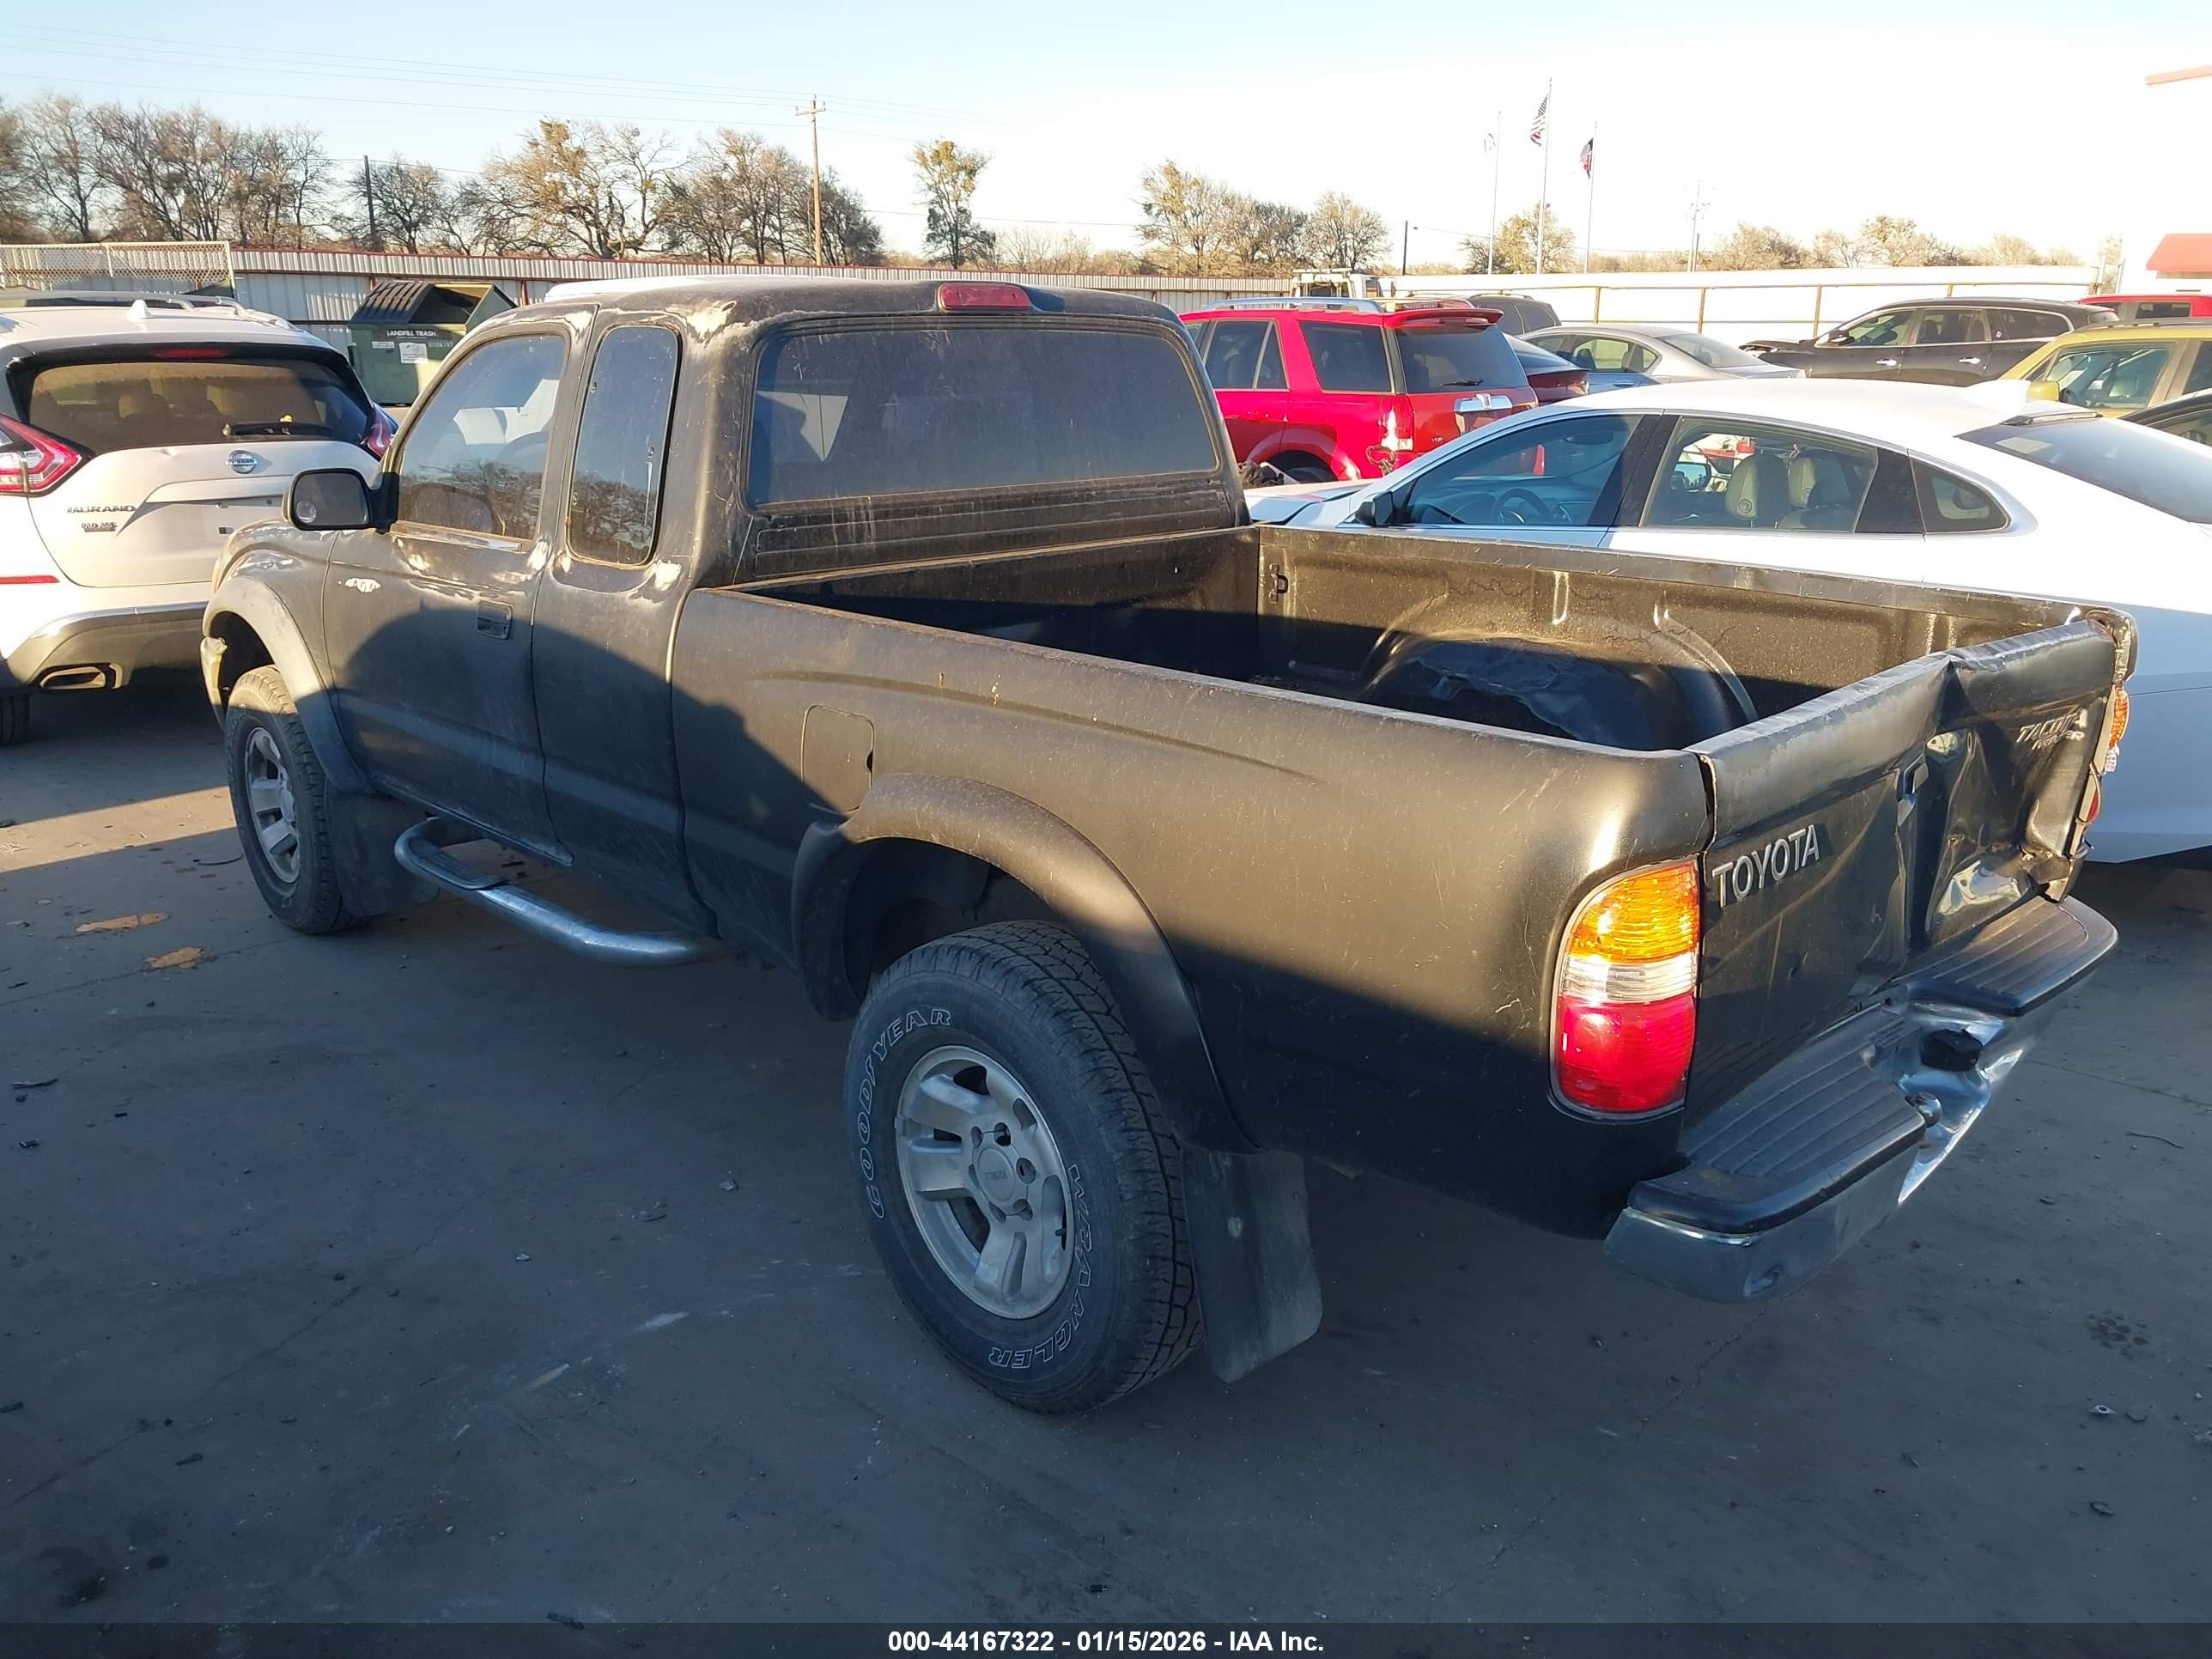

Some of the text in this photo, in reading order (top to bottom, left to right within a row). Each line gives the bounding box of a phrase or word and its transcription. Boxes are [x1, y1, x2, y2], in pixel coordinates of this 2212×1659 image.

[67, 505, 137, 514] MURANO
[1712, 824, 1819, 907] TOYOTA
[858, 1008, 951, 1218] GOODYEAR
[988, 1164, 1092, 1368] WRANGLER
